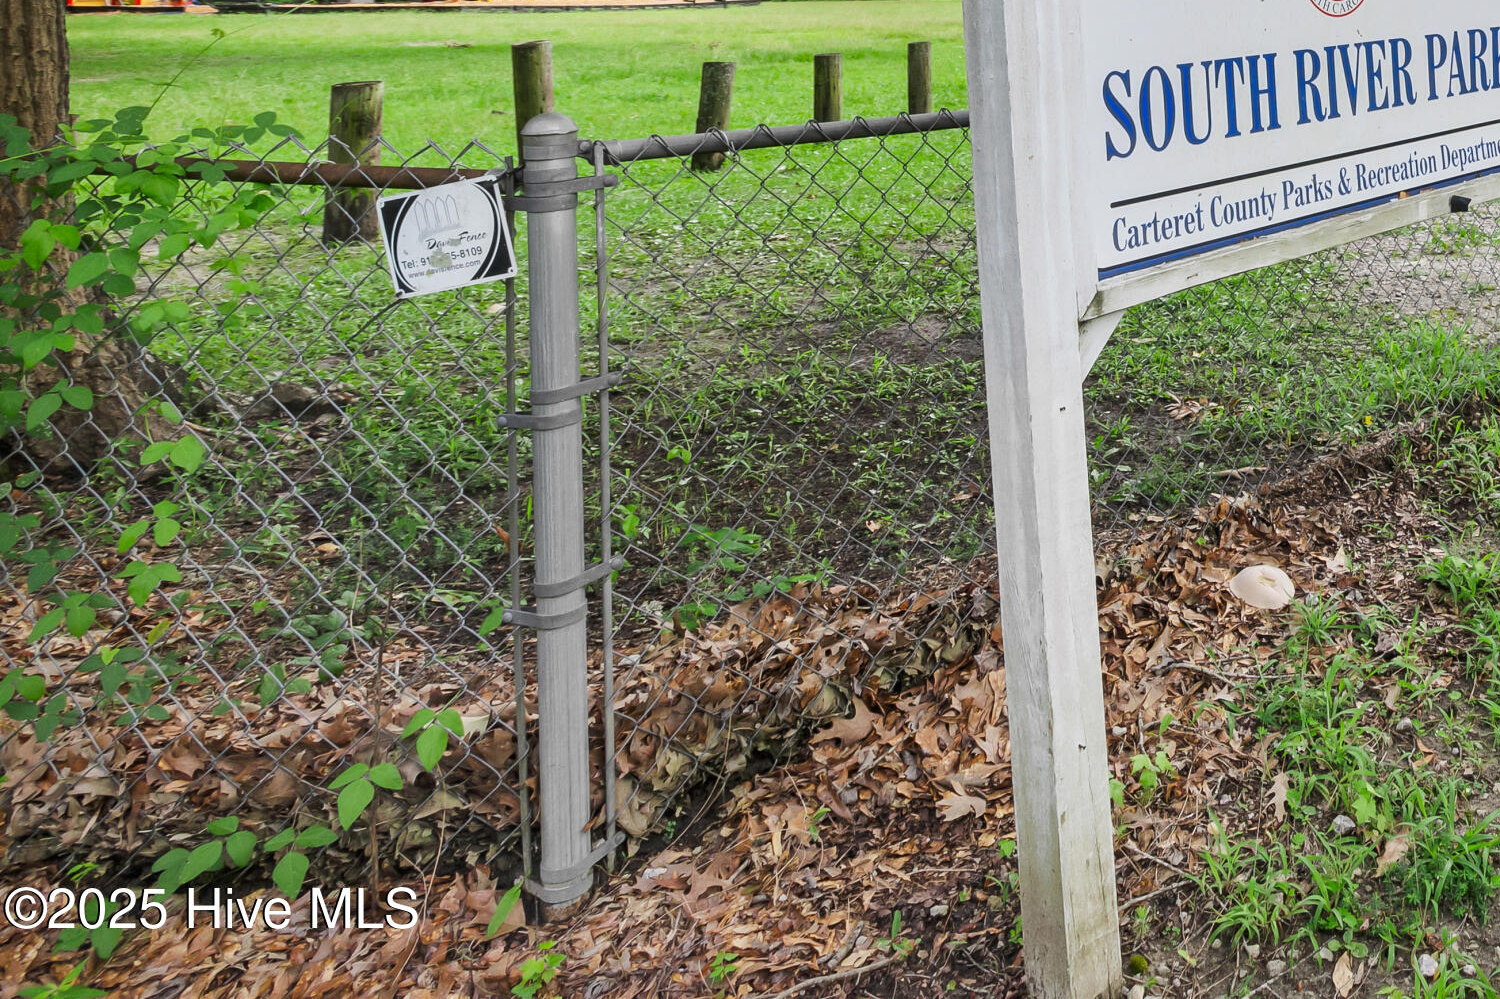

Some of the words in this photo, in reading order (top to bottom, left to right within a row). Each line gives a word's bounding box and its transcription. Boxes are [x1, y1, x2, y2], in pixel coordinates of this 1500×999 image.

[1102, 52, 1282, 161] SOUTH
[1292, 37, 1417, 125] RIVER
[1112, 201, 1204, 251] Carteret
[1210, 186, 1277, 221] County
[1282, 173, 1333, 210] Parks
[1338, 166, 1352, 196] &
[1355, 151, 1437, 192] Recreation
[401, 259, 419, 269] Tel:
[420, 245, 482, 266] 915-8109
[425, 238, 459, 250] Dav
